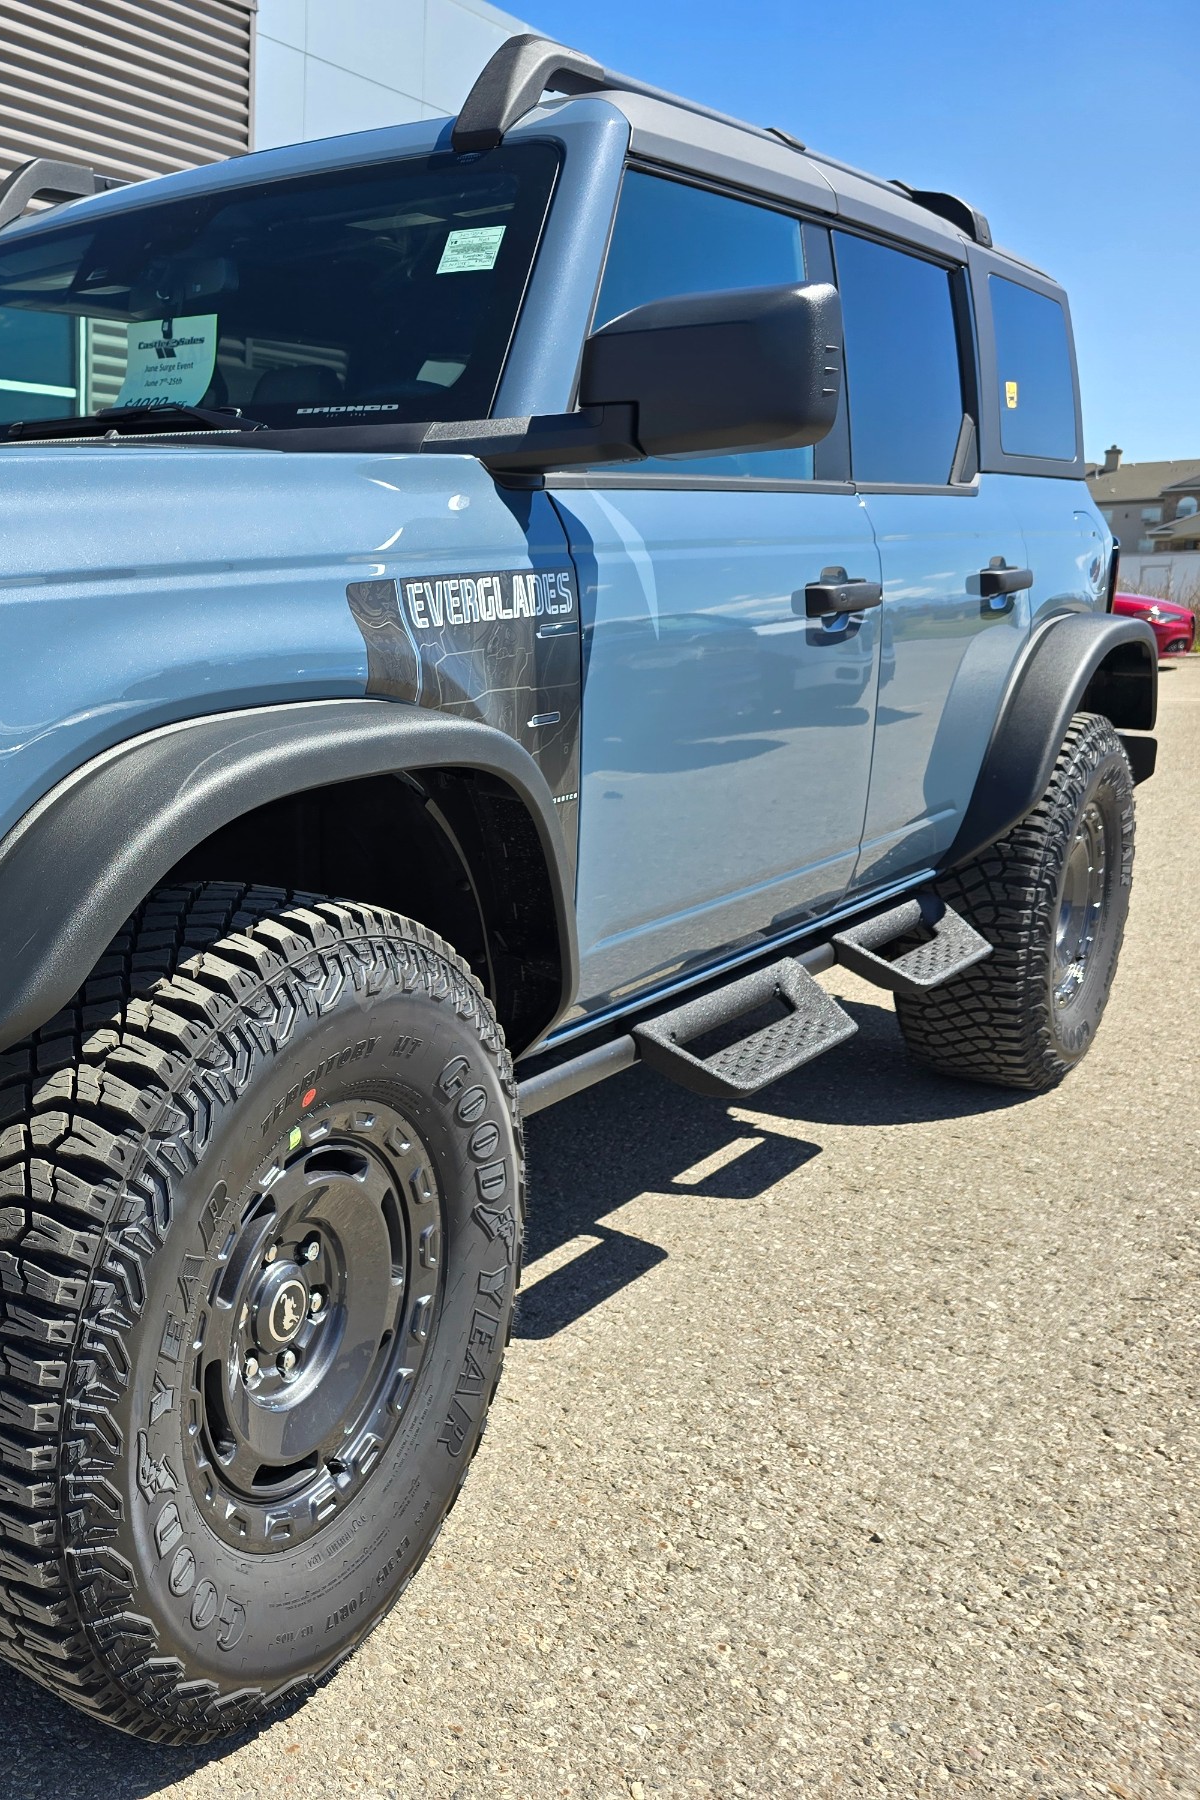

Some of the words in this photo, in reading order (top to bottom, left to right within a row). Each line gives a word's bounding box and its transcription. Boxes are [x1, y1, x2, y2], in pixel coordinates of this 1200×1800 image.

[144, 364, 158, 373] June
[159, 363, 176, 373] Surge
[176, 361, 194, 370] Event
[144, 379, 158, 387] June
[296, 403, 399, 415] BRONCO
[406, 572, 574, 629] EVERGLADES
[261, 1036, 382, 1137] TERRITORY
